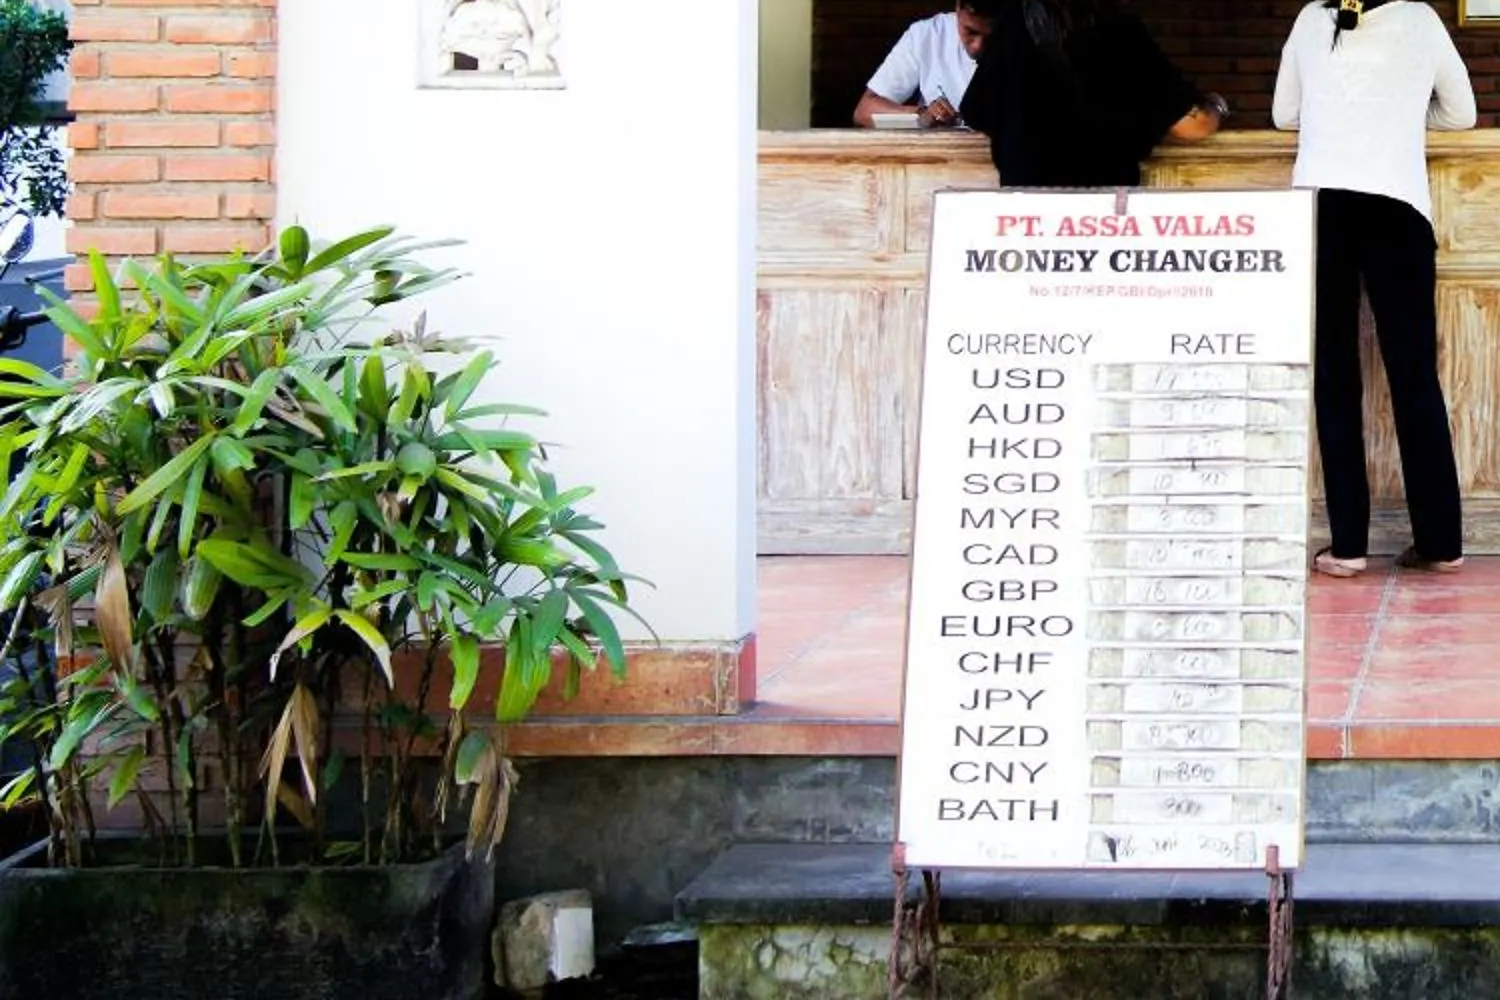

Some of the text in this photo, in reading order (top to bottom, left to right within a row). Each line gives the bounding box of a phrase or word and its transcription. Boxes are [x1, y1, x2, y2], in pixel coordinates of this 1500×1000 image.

[996, 214, 1256, 237] PT. ASSA VALAS
[964, 249, 1287, 273] MONEY CHANGER
[947, 333, 1257, 356] CURRENCY RATE
[972, 367, 1066, 389] USD
[968, 403, 1065, 425] AUD
[967, 437, 1063, 459] HKD
[962, 472, 1061, 494] SGD
[959, 507, 1061, 530] MYR
[962, 544, 1059, 566] CAD
[961, 580, 1059, 602] GBP
[940, 615, 1074, 637] EURO
[957, 652, 1054, 674] CHF
[959, 689, 1046, 711] JPY
[953, 725, 1049, 747] NZD
[948, 761, 1049, 784] CNY
[937, 799, 1059, 821] BATH
